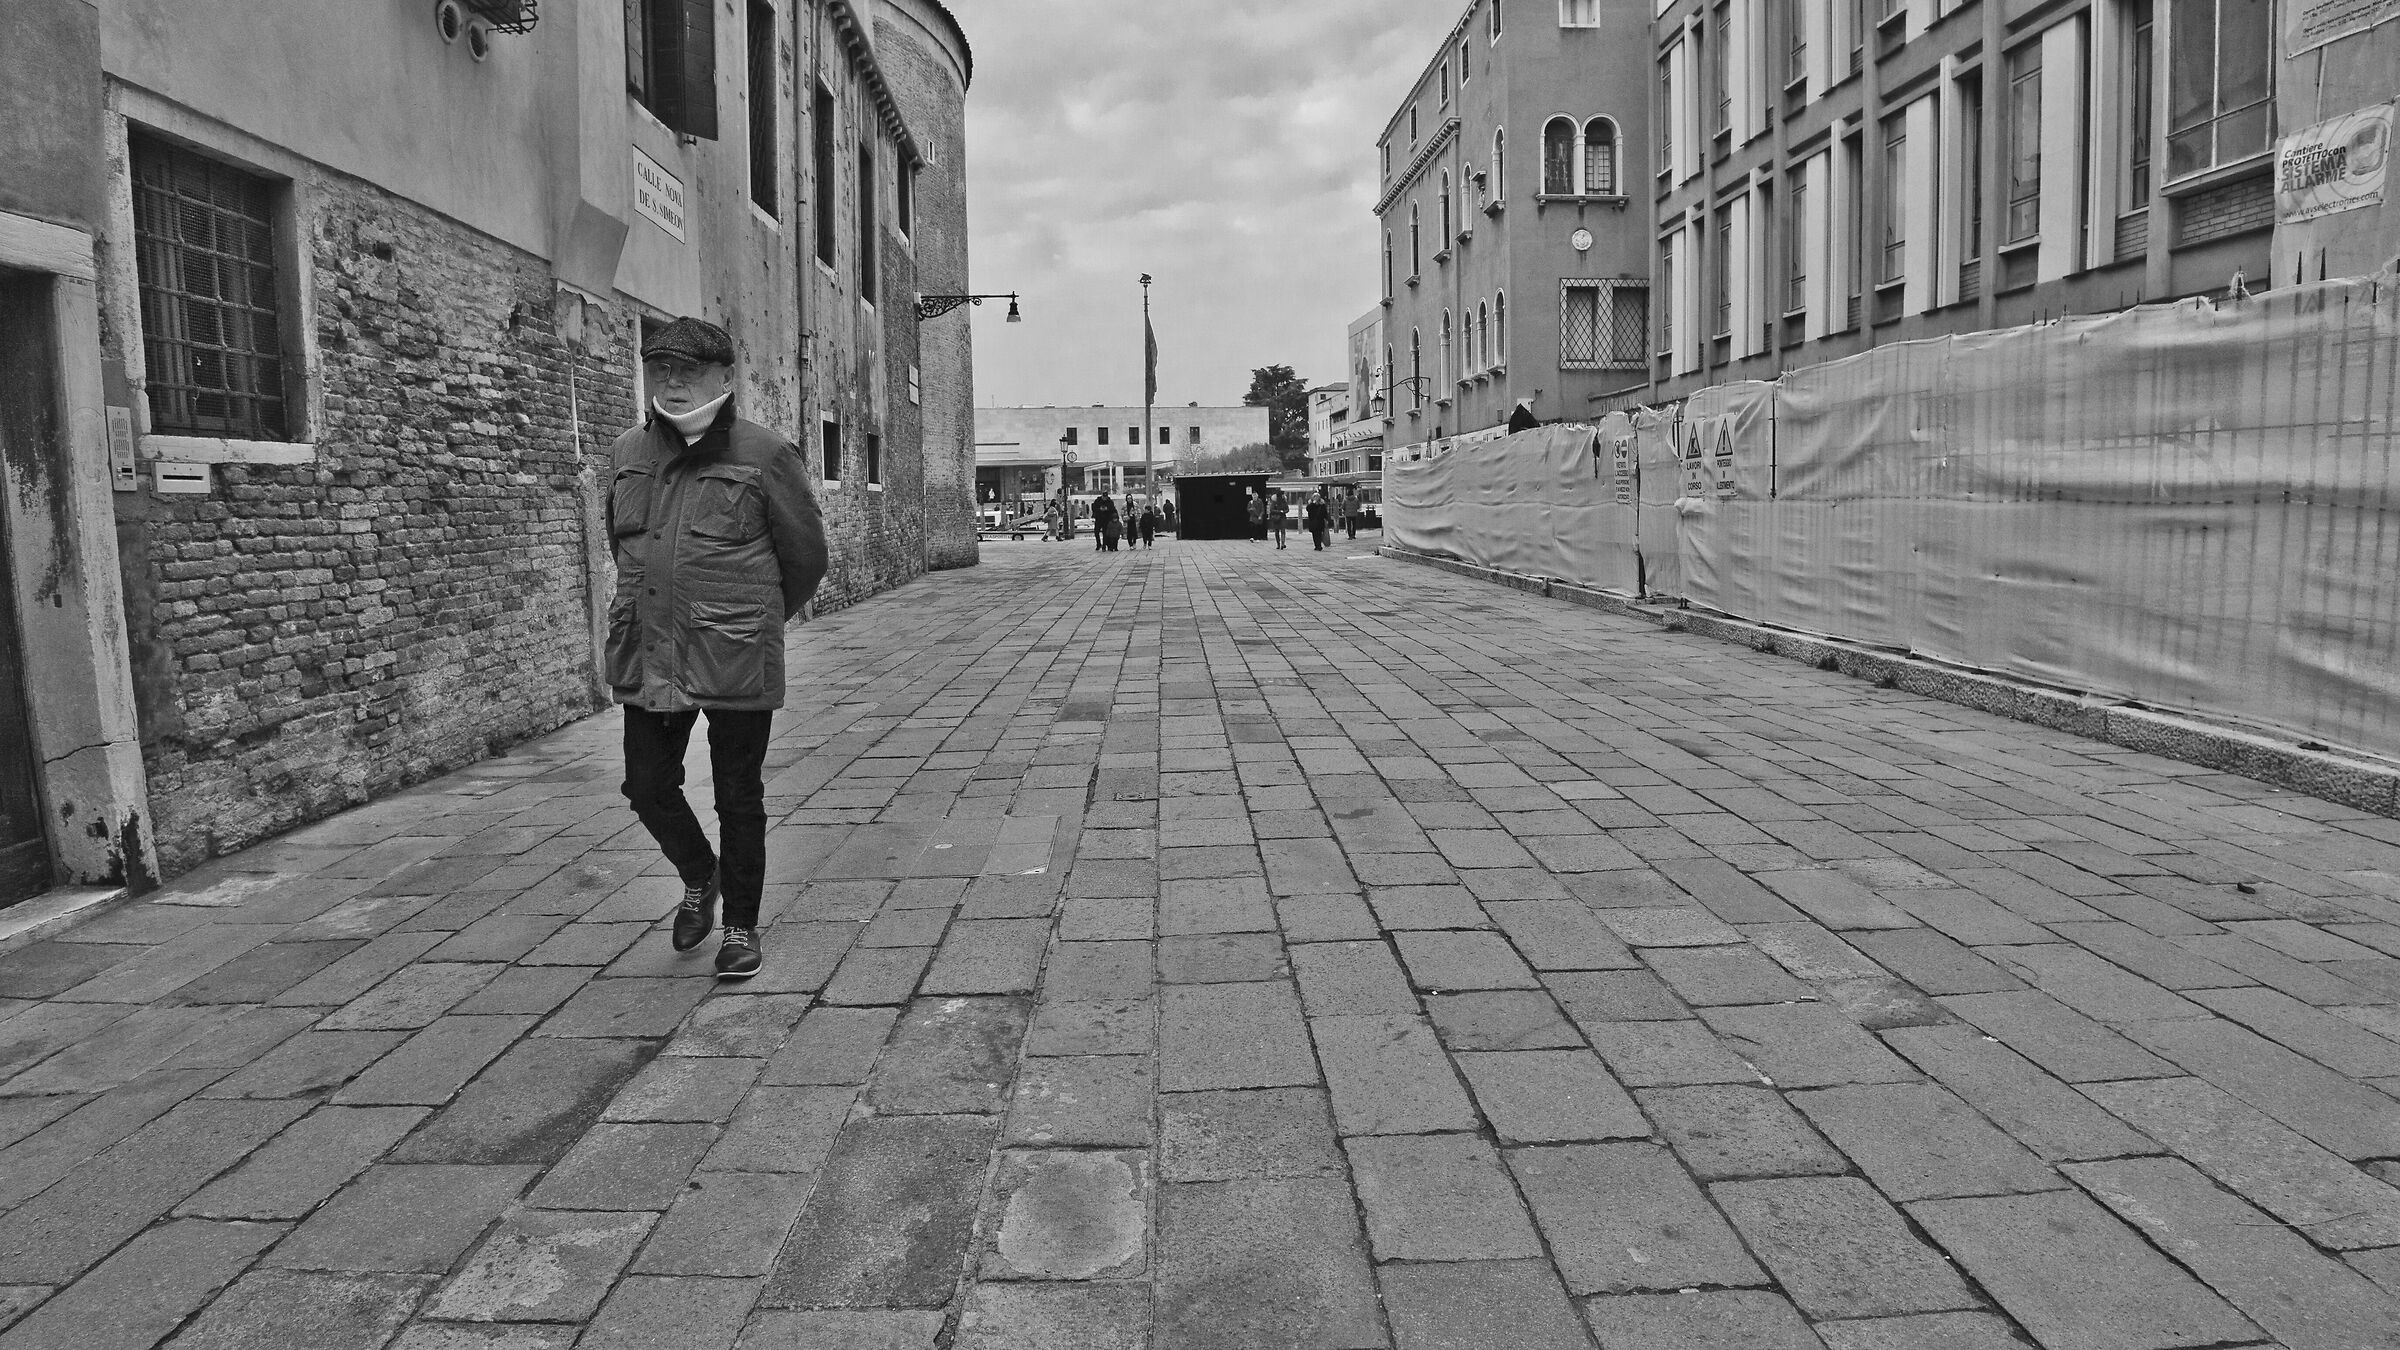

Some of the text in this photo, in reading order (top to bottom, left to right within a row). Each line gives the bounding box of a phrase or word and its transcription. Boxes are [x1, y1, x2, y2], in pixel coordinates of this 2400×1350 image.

[2284, 142, 2324, 158] Cantiere
[2281, 153, 2347, 181] SISTEMA
[637, 162, 683, 207] CALLE NOVA
[2280, 166, 2347, 194] ALLARME
[639, 188, 651, 208] DE
[1687, 461, 1702, 470] LAVORI
[1688, 482, 1702, 490] CORSO
